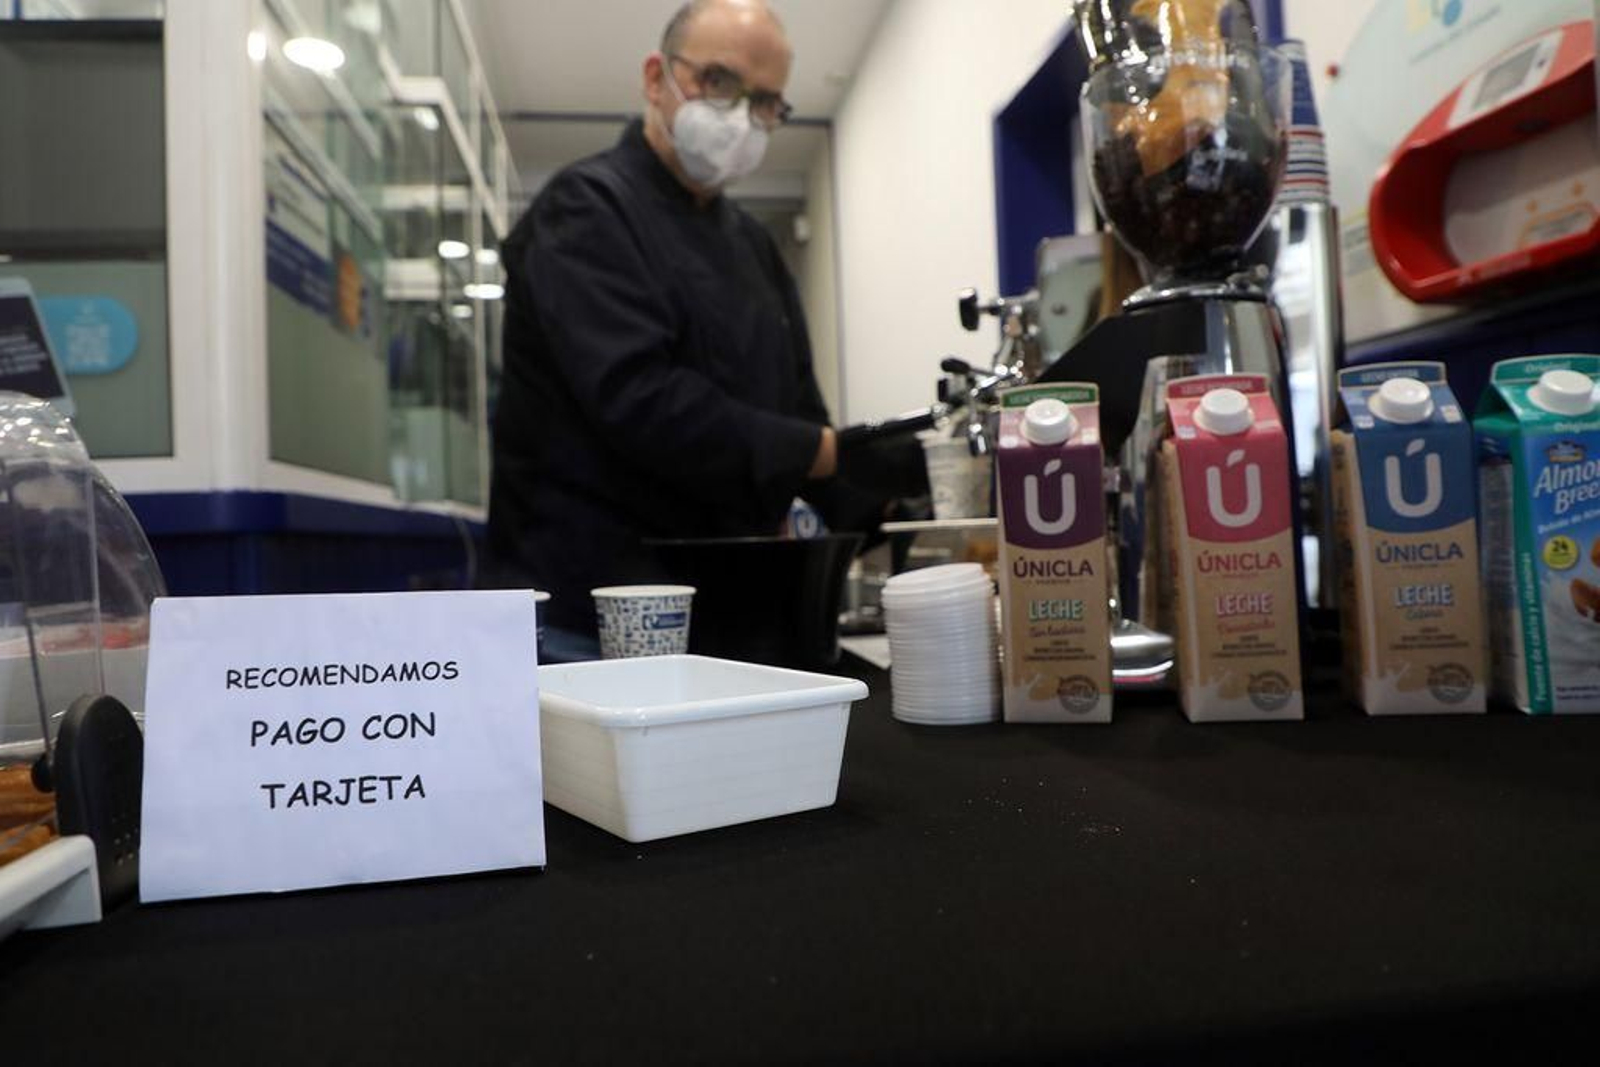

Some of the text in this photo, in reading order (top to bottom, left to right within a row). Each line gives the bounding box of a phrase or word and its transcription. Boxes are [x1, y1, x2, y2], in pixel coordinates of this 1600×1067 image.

[1197, 550, 1282, 574] ÚNICLA
[1376, 541, 1463, 563] ÚNICLA
[1013, 556, 1094, 578] ÚNICLA
[1215, 593, 1274, 618] LECHE
[1394, 584, 1455, 608] LECHE
[1028, 599, 1084, 622] LECHE
[226, 661, 460, 690] RECOMENDAMOS
[250, 711, 437, 748] PAGO CON
[260, 774, 427, 810] TARJETA
